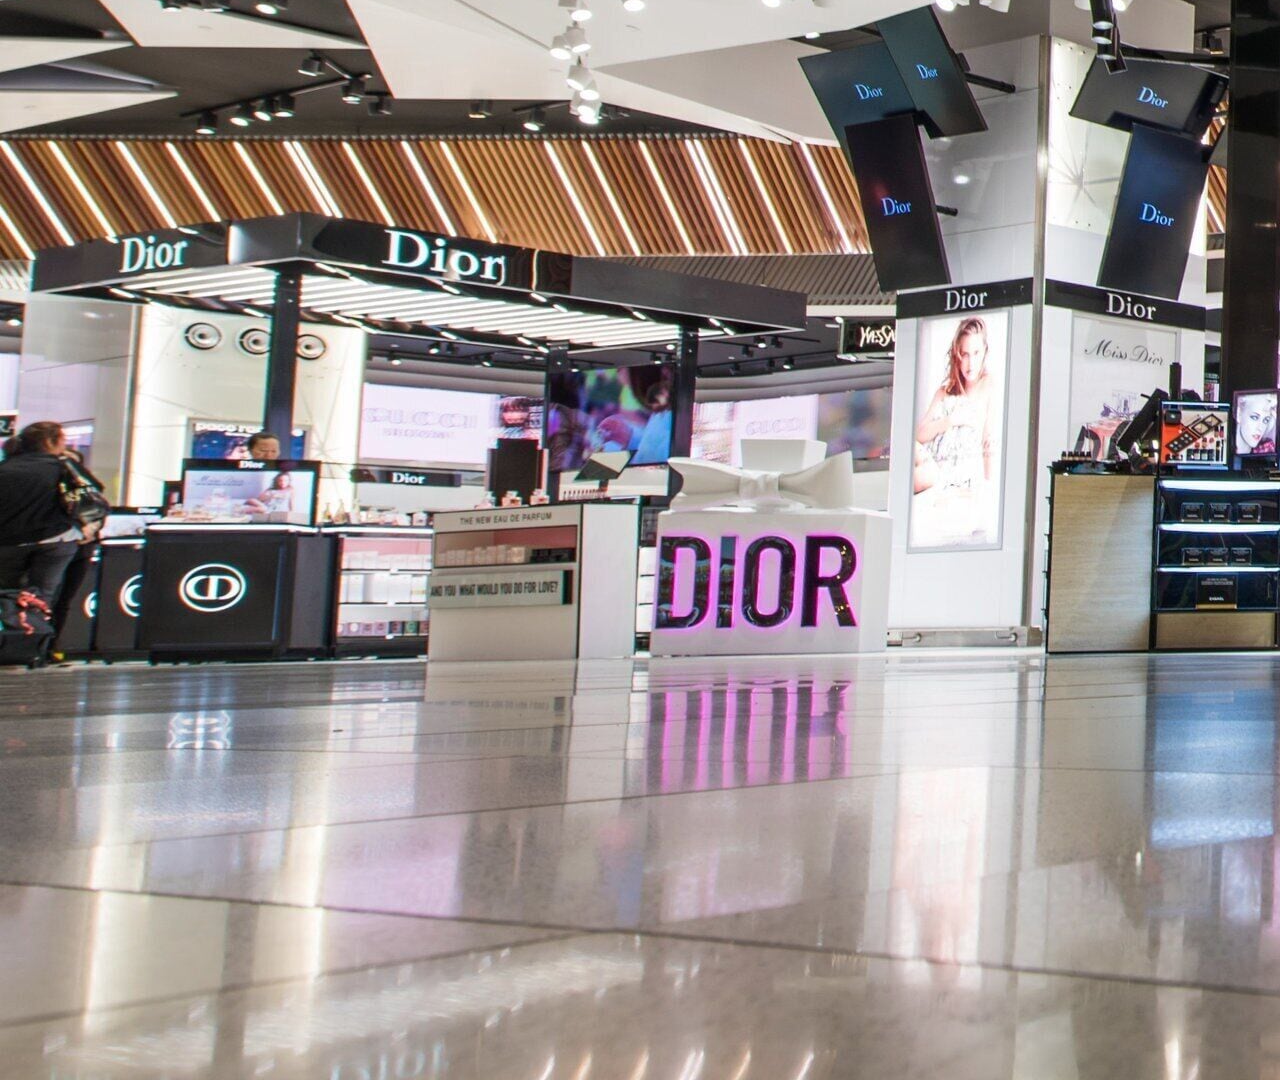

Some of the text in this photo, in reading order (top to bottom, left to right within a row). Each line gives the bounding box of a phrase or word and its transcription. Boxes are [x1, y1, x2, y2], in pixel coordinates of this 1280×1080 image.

[916, 63, 939, 80] Dior
[855, 83, 884, 101] Dior
[1136, 86, 1169, 109] Dior
[881, 197, 912, 217] Dior
[1139, 202, 1175, 227] Dior
[119, 235, 188, 273] Dior
[381, 229, 505, 281] Dior
[944, 289, 988, 311] Dior
[1106, 292, 1157, 320] Dior
[1084, 339, 1164, 366] Miss Dior
[391, 472, 426, 485] Dior
[460, 511, 552, 526] THE NEW EAU DE PARFUM
[430, 580, 558, 597] AND YOU WHAT WOULD YOU DO FOR LOVE?
[655, 535, 857, 629] DIOR
